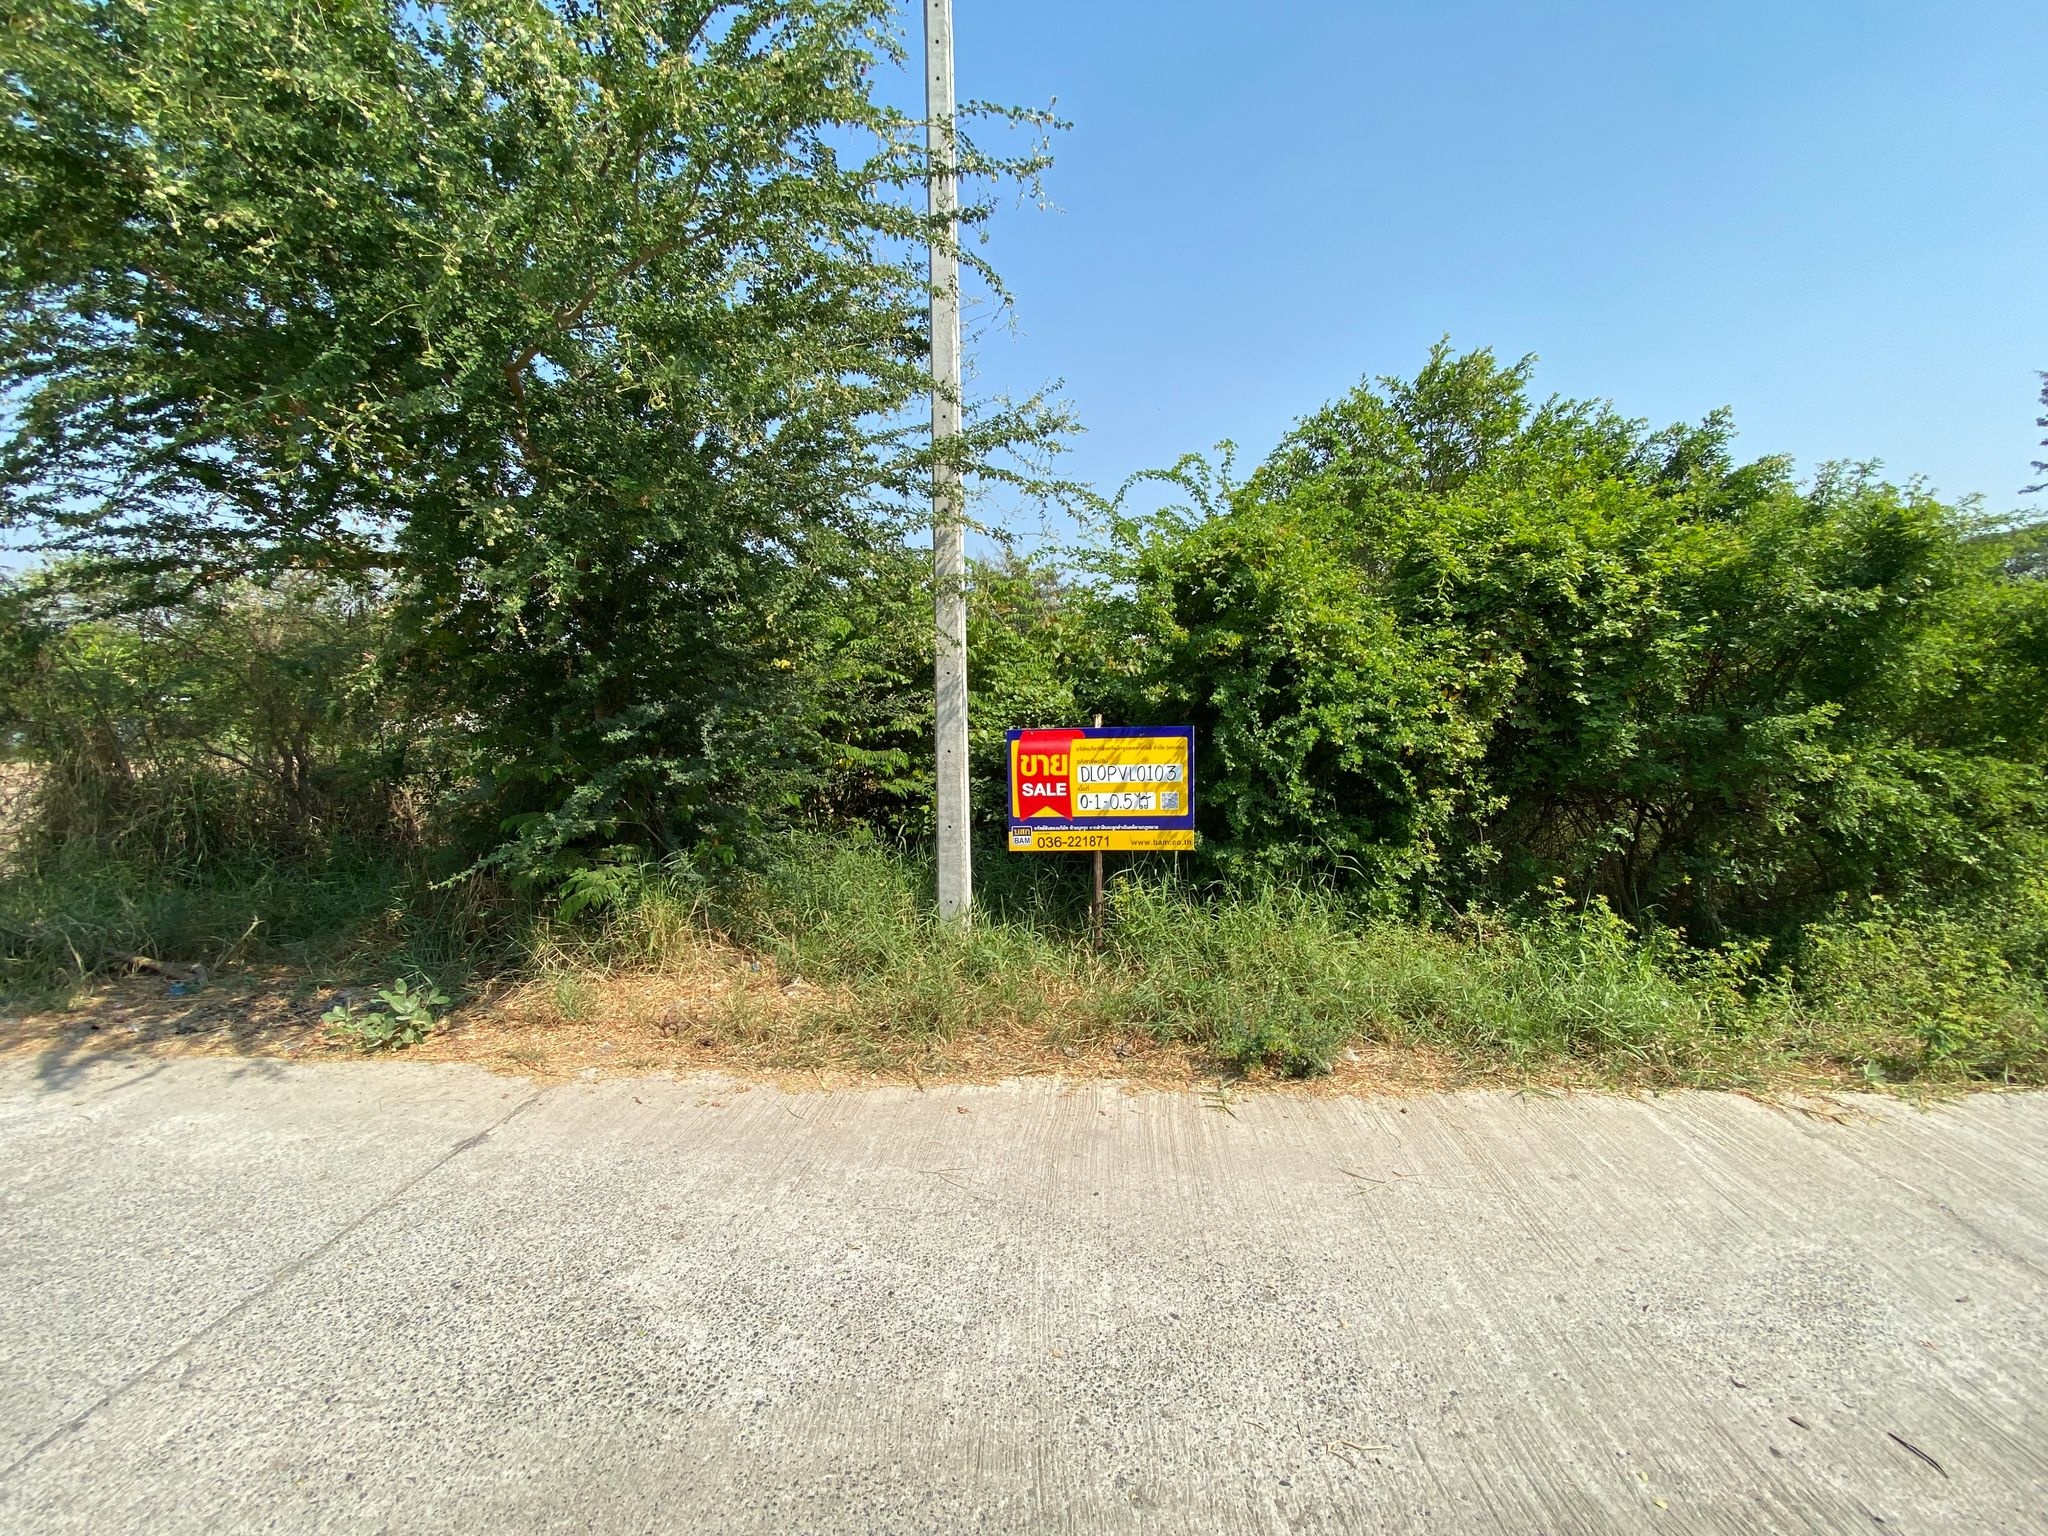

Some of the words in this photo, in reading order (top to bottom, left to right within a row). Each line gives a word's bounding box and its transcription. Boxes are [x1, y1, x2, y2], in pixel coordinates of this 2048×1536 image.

[1020, 754, 1068, 777] ขาย
[1021, 782, 1067, 797] SALE
[1014, 837, 1031, 845] BAM
[1037, 835, 1110, 849] 036-221871
